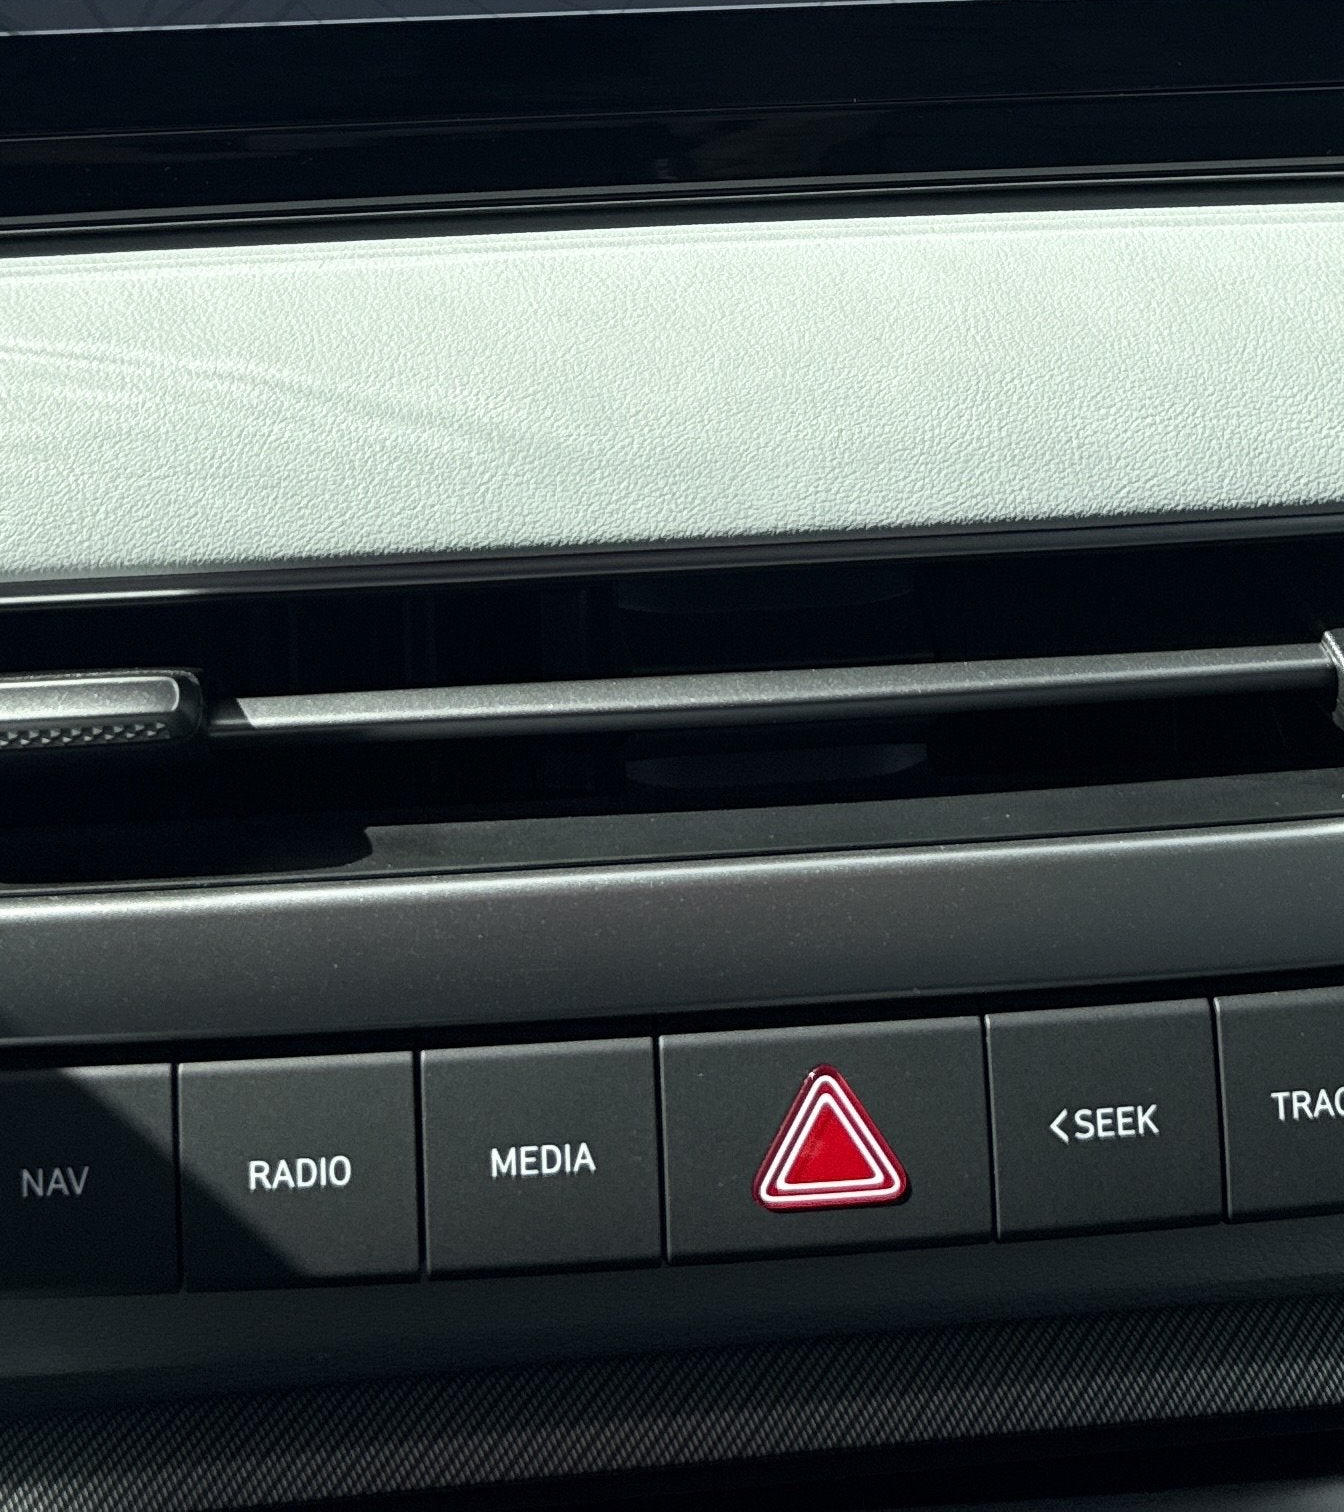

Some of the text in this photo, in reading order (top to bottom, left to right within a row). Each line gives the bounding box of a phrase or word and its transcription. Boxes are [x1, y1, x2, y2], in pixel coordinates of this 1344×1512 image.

[248, 1155, 353, 1192] RADIO
[489, 1142, 597, 1180] MEDIA
[21, 1166, 90, 1199] NAV
